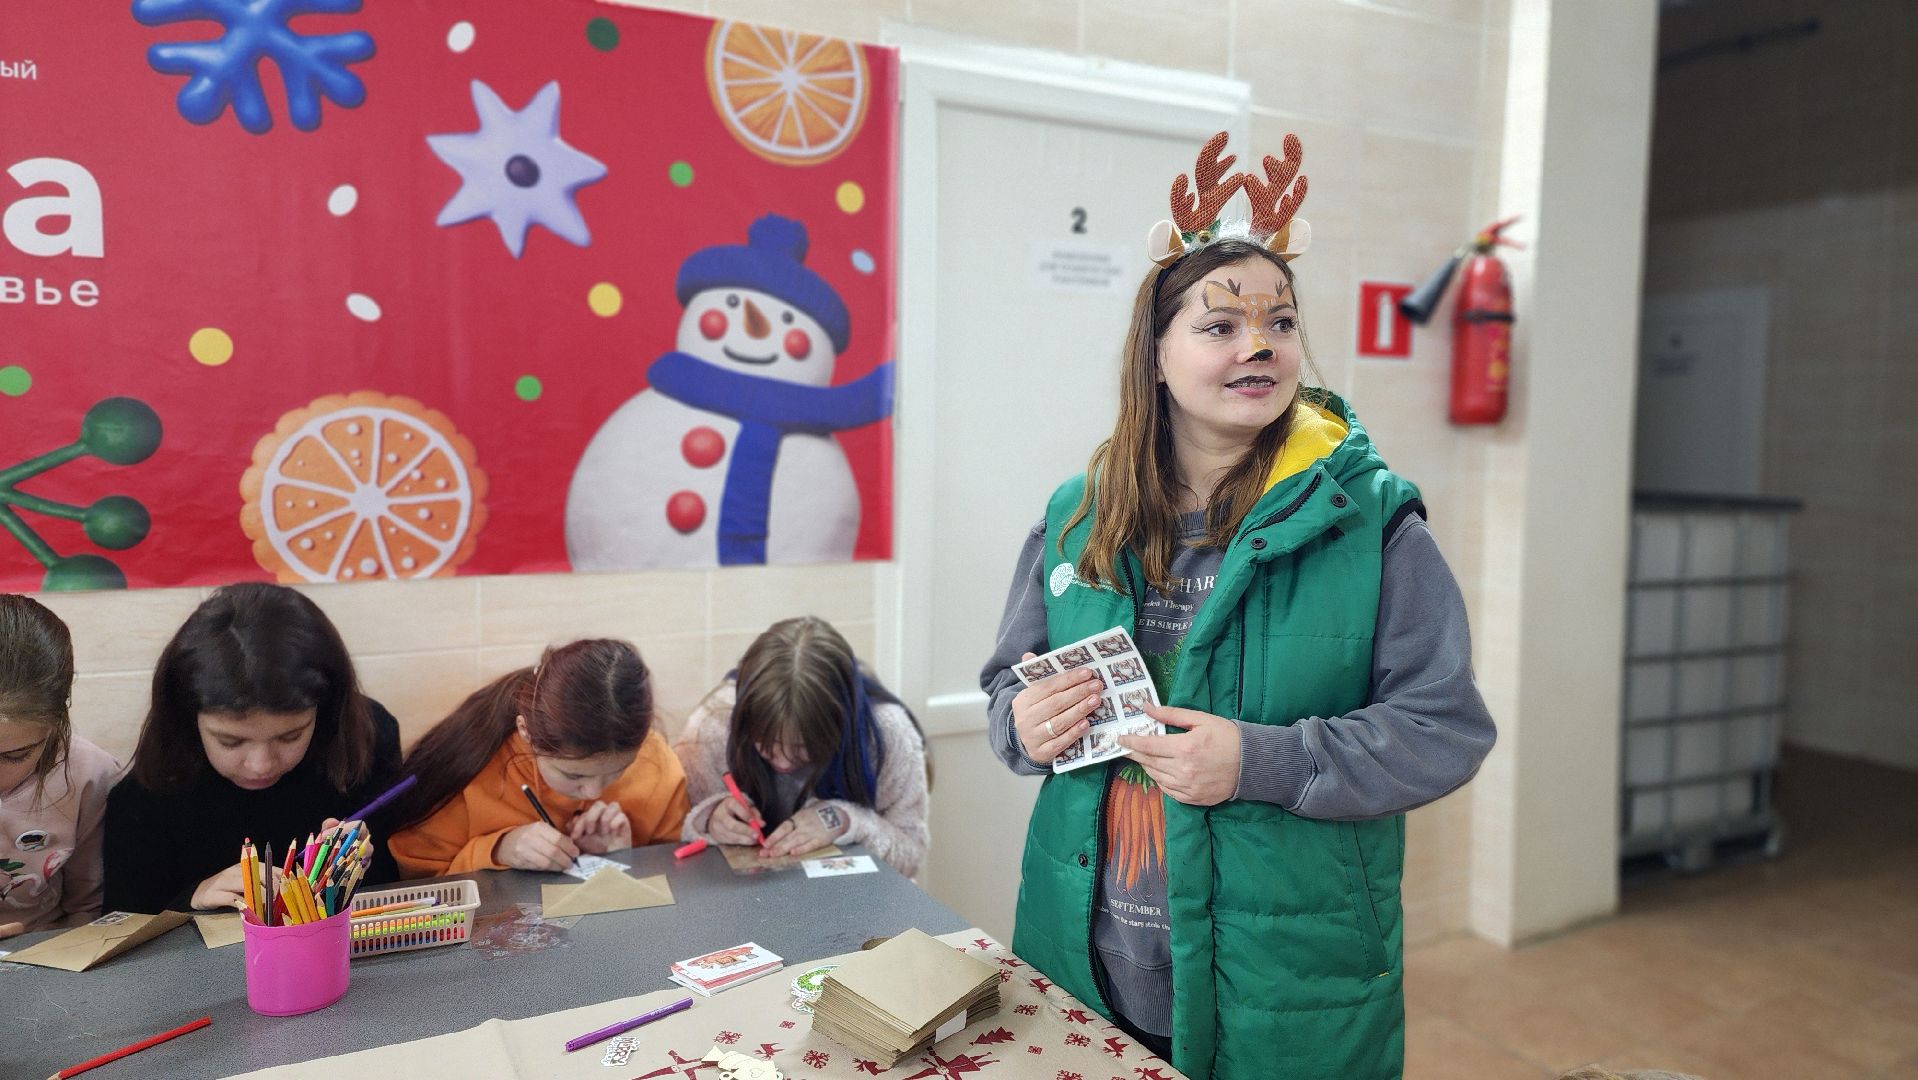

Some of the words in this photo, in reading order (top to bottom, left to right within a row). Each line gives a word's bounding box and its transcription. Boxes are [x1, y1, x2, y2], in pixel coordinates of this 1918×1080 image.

[1070, 206, 1087, 234] 2
[1180, 575, 1218, 594] HAR
[1163, 599, 1194, 612] Therapy
[1146, 619, 1156, 627] IS
[1110, 899, 1162, 916] SEPTEMBER
